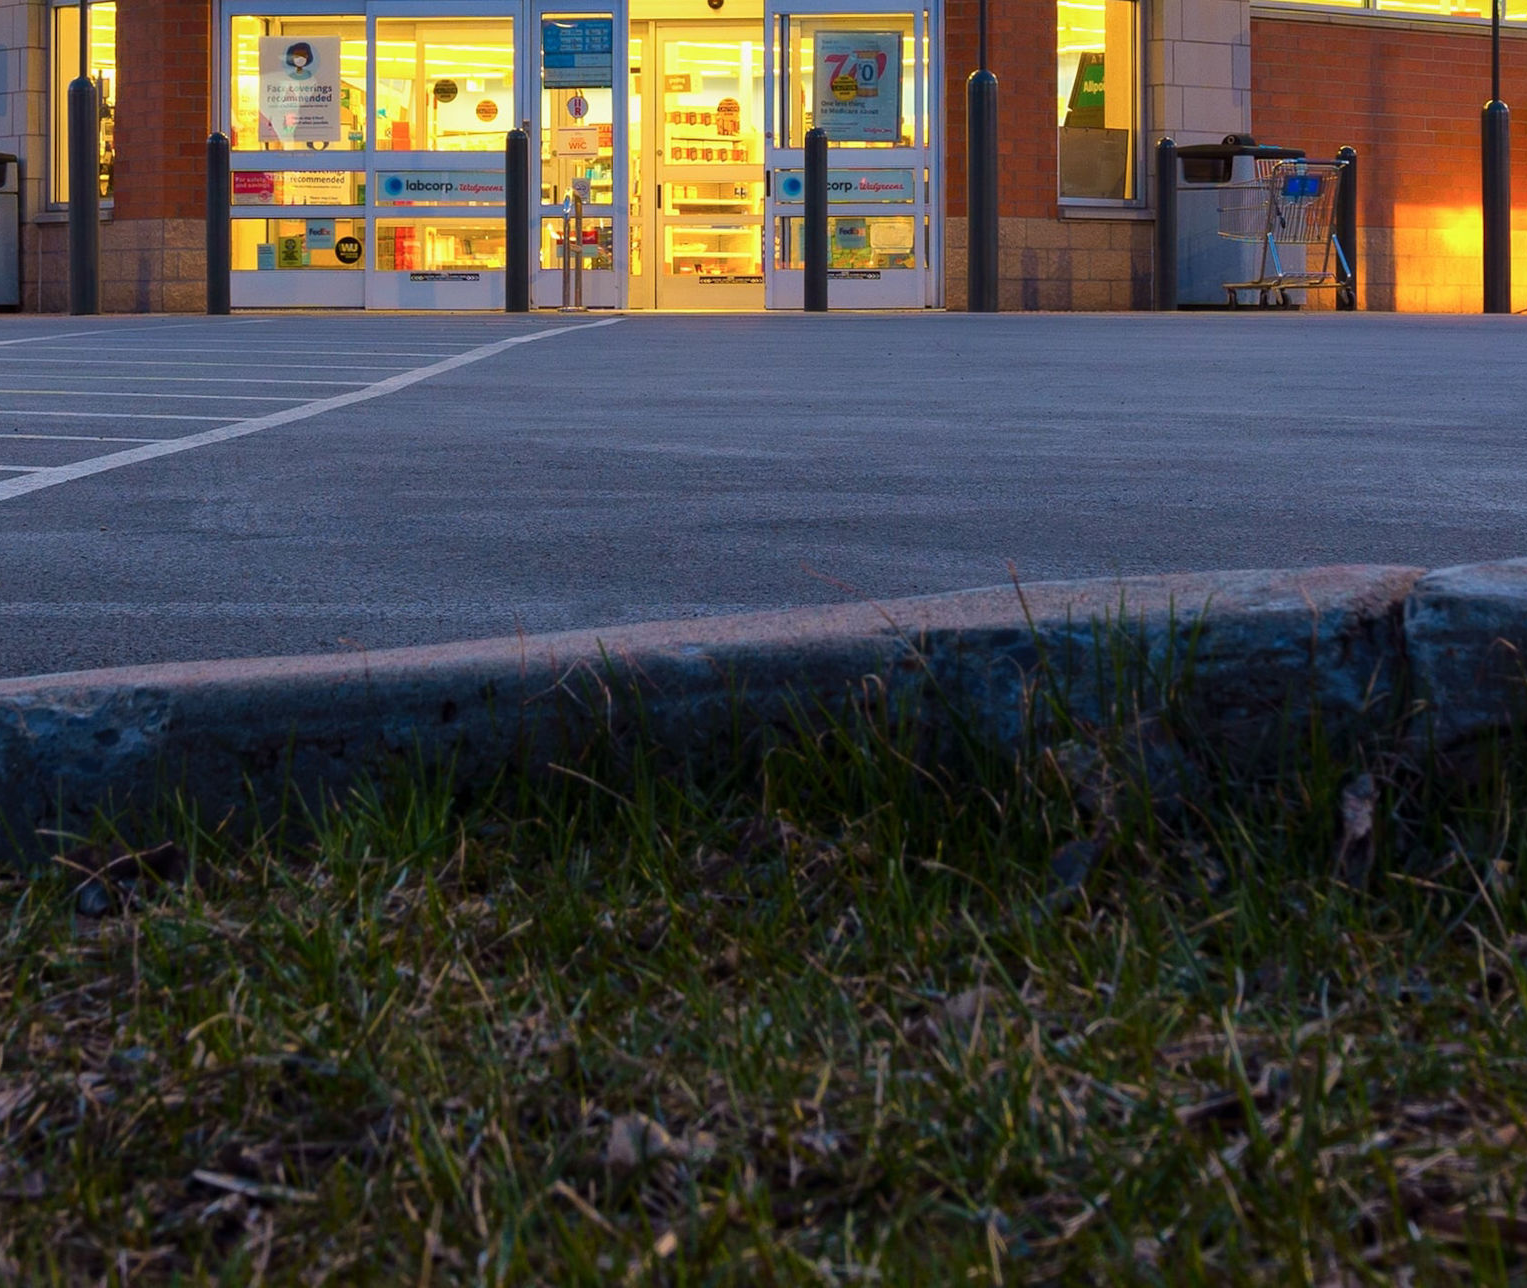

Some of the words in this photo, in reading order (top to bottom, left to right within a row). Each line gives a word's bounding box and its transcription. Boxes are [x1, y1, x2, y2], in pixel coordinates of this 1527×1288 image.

[1083, 80, 1105, 95] Allpo
[568, 142, 587, 150] WIC
[405, 179, 454, 193] labcorp
[458, 183, 504, 194] Walgreens
[859, 180, 905, 192] Walgreens
[308, 227, 331, 236] FedEx
